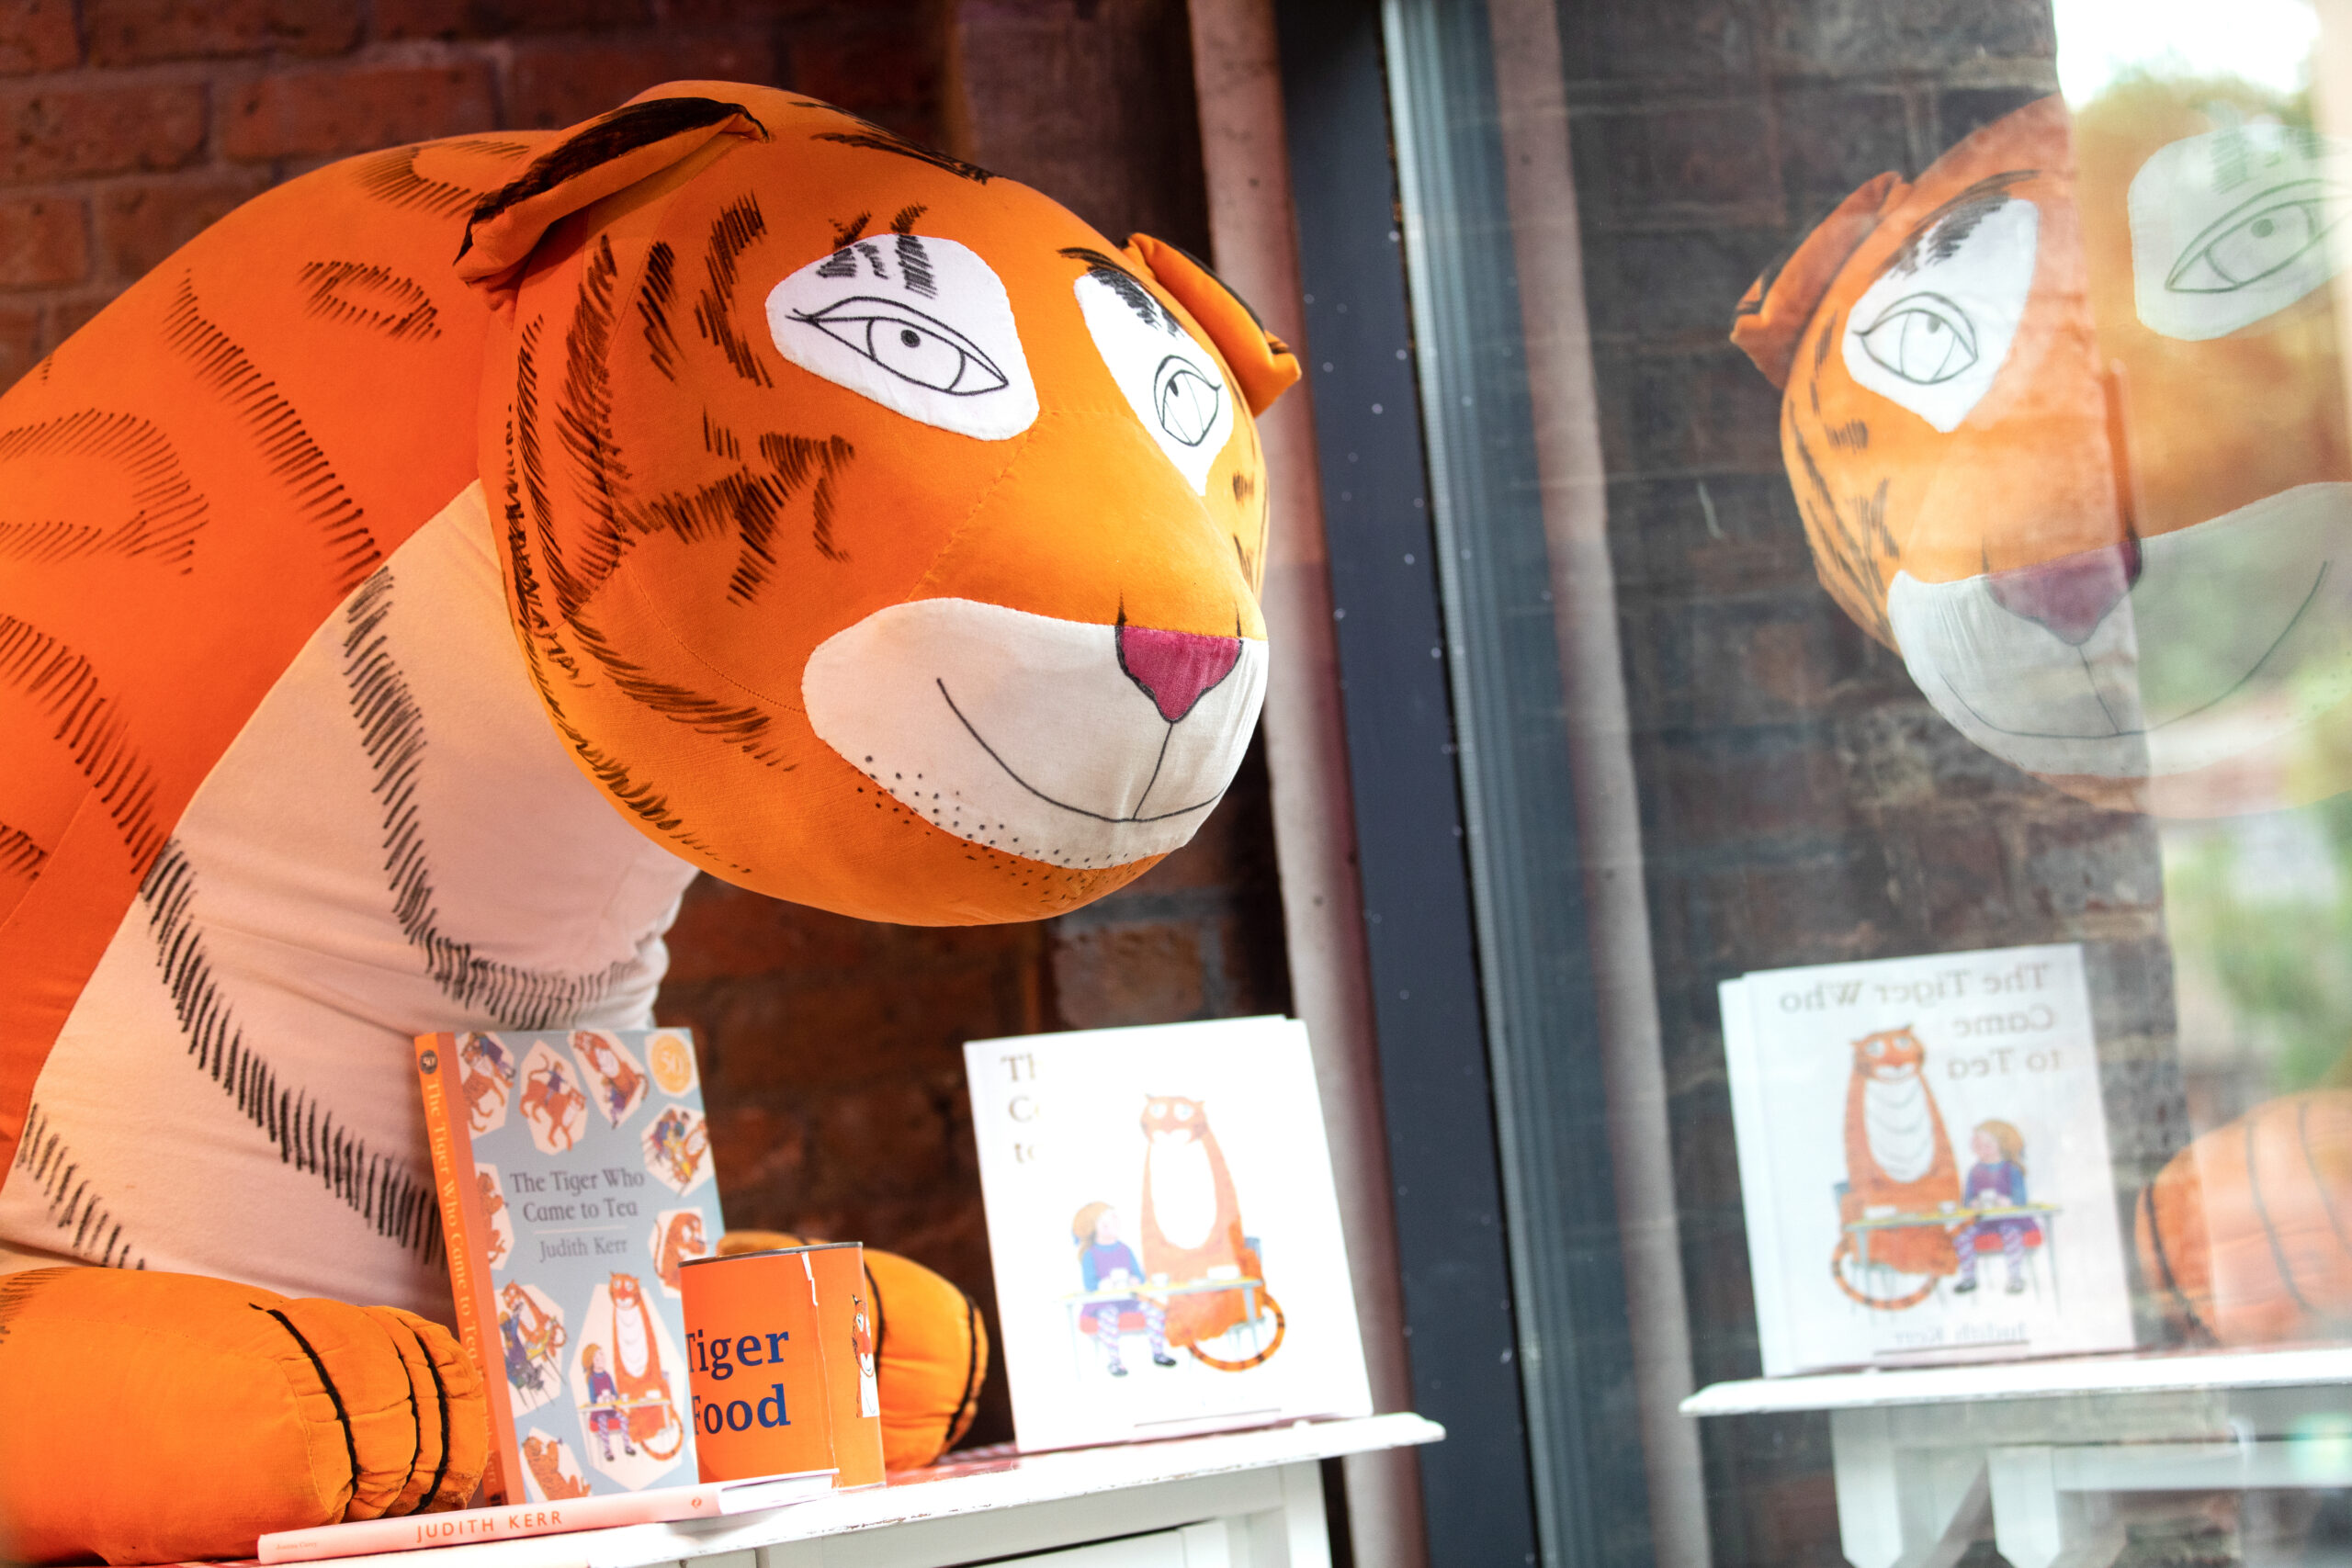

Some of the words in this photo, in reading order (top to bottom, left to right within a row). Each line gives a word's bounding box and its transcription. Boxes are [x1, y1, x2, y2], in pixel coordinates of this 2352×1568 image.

[426, 1078, 442, 1117] The
[432, 1121, 450, 1175] Tiger
[509, 1172, 546, 1193] The
[549, 1169, 598, 1197] Tiger
[601, 1167, 646, 1188] Who
[442, 1179, 458, 1227] Who
[523, 1201, 575, 1223] Came
[581, 1202, 600, 1220] to
[603, 1197, 639, 1219] Tea
[450, 1233, 468, 1290] Came
[538, 1236, 589, 1264] Judith
[594, 1235, 628, 1256] Kerr
[459, 1295, 471, 1316] to
[464, 1320, 479, 1359] Tea
[416, 1517, 495, 1543] JUDITH
[507, 1510, 563, 1530] KERR
